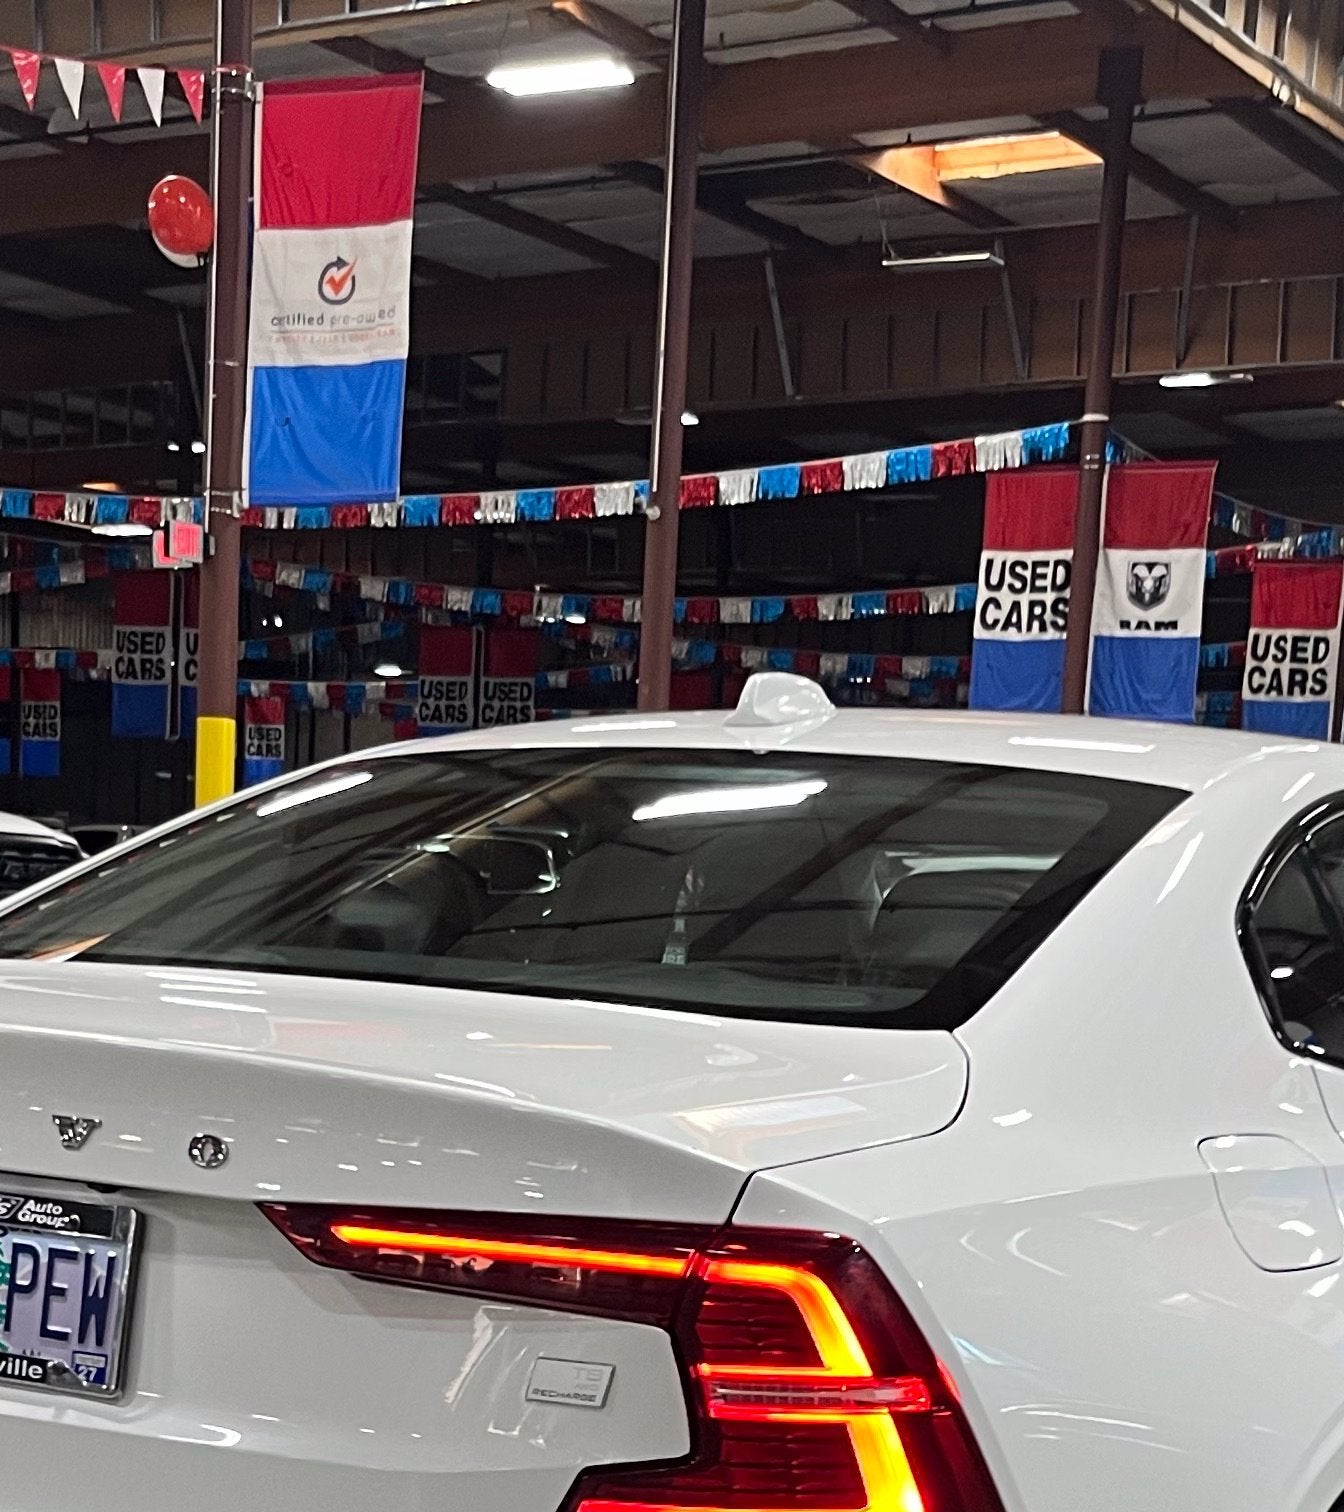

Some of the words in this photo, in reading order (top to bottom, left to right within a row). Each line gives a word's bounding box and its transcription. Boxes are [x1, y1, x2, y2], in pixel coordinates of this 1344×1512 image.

[984, 558, 1072, 594] USED
[979, 597, 1069, 633] CARS
[1119, 619, 1178, 631] RAM
[116, 630, 166, 654] USED
[1250, 633, 1330, 665] USED
[115, 657, 166, 681] CARS
[420, 679, 468, 701] USED
[483, 681, 532, 701] USED
[1247, 666, 1328, 697] CARS
[419, 702, 468, 723] CARS
[481, 704, 531, 724] CARS
[248, 727, 282, 742] USED
[247, 742, 282, 758] CARS
[22, 1199, 63, 1215] Auto
[17, 1210, 66, 1229] Group
[4, 1241, 116, 1347] PEW
[77, 1365, 97, 1382] 27
[532, 1387, 598, 1403] RECHARGE
